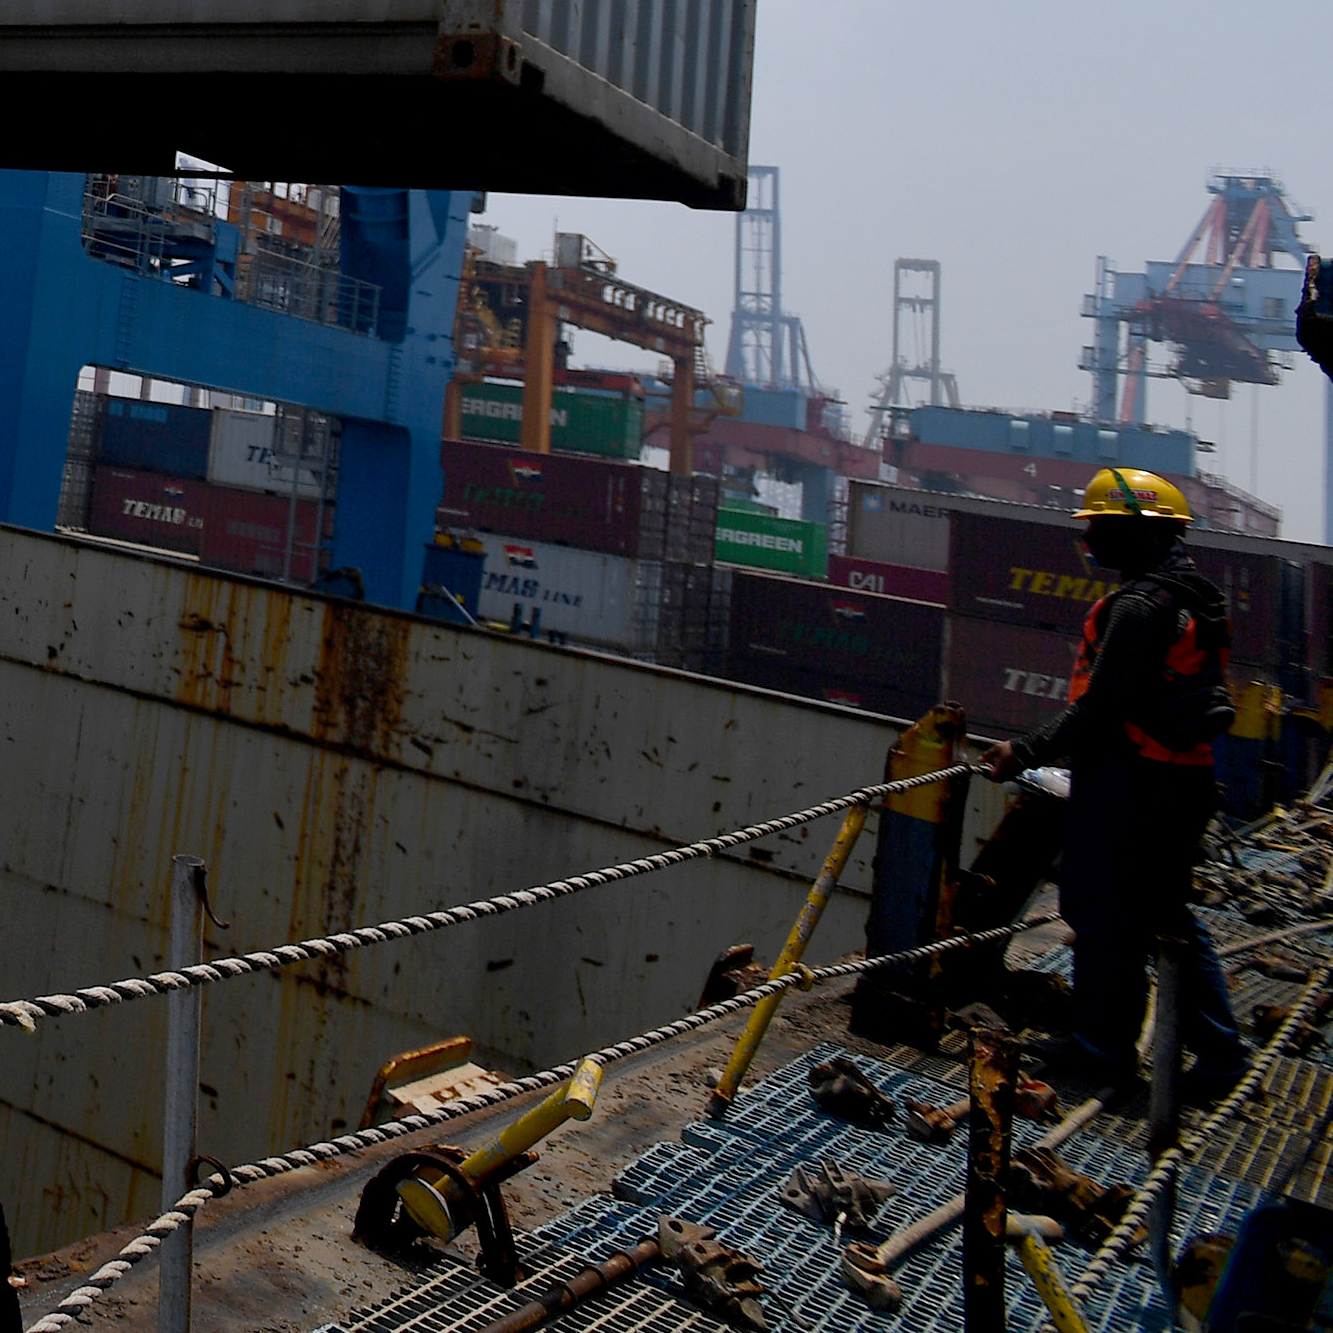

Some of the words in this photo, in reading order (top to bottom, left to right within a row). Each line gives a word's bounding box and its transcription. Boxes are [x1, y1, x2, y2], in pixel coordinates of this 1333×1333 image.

[122, 498, 187, 525] TEMAS
[890, 500, 951, 520] MAER
[715, 526, 803, 554] ERGREEN
[484, 571, 540, 599] MAS
[544, 589, 583, 607] LINE
[848, 570, 885, 593] CAI
[1009, 565, 1123, 603] TEMA
[1003, 667, 1070, 702] TEM
